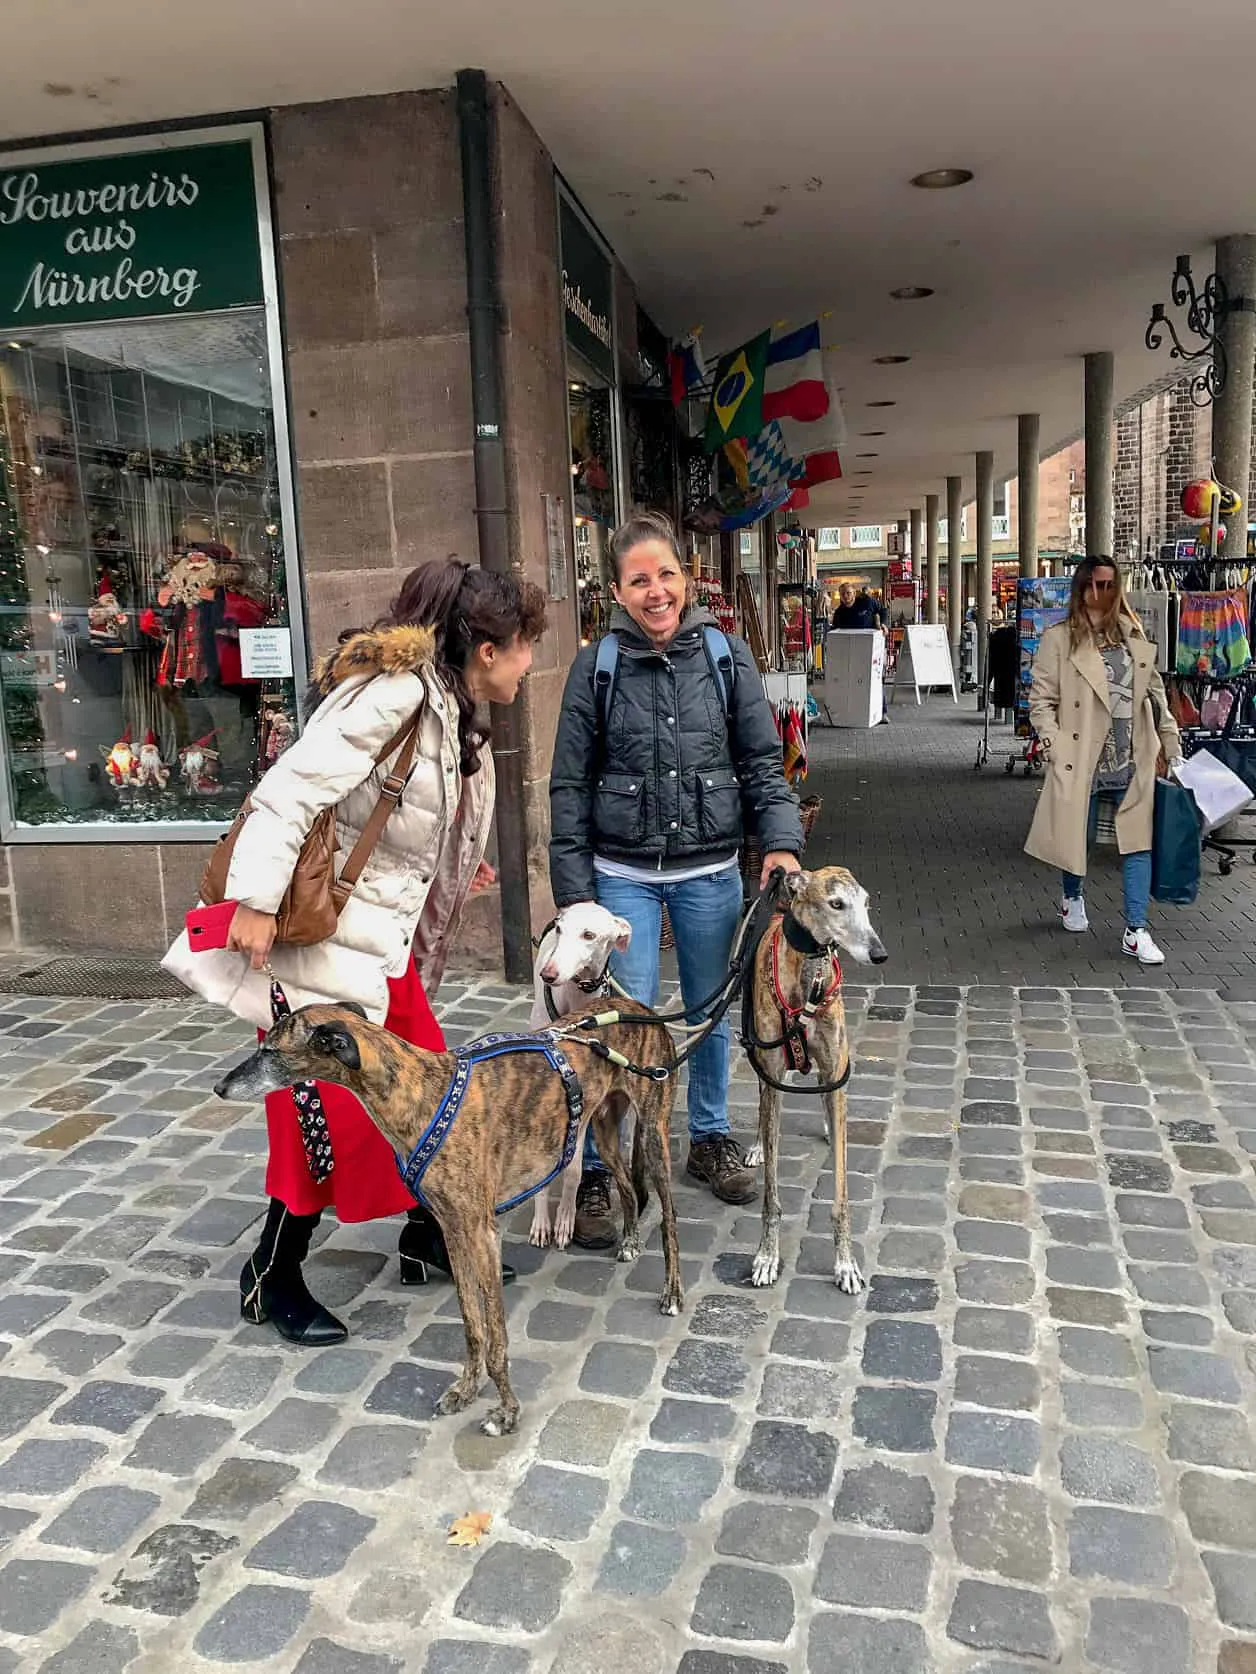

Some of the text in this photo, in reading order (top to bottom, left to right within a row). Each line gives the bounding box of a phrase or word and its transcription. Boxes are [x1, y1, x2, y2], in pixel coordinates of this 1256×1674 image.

[0, 172, 200, 225] Souvenirs
[65, 218, 137, 255] aus
[13, 257, 201, 313] Nürnberg
